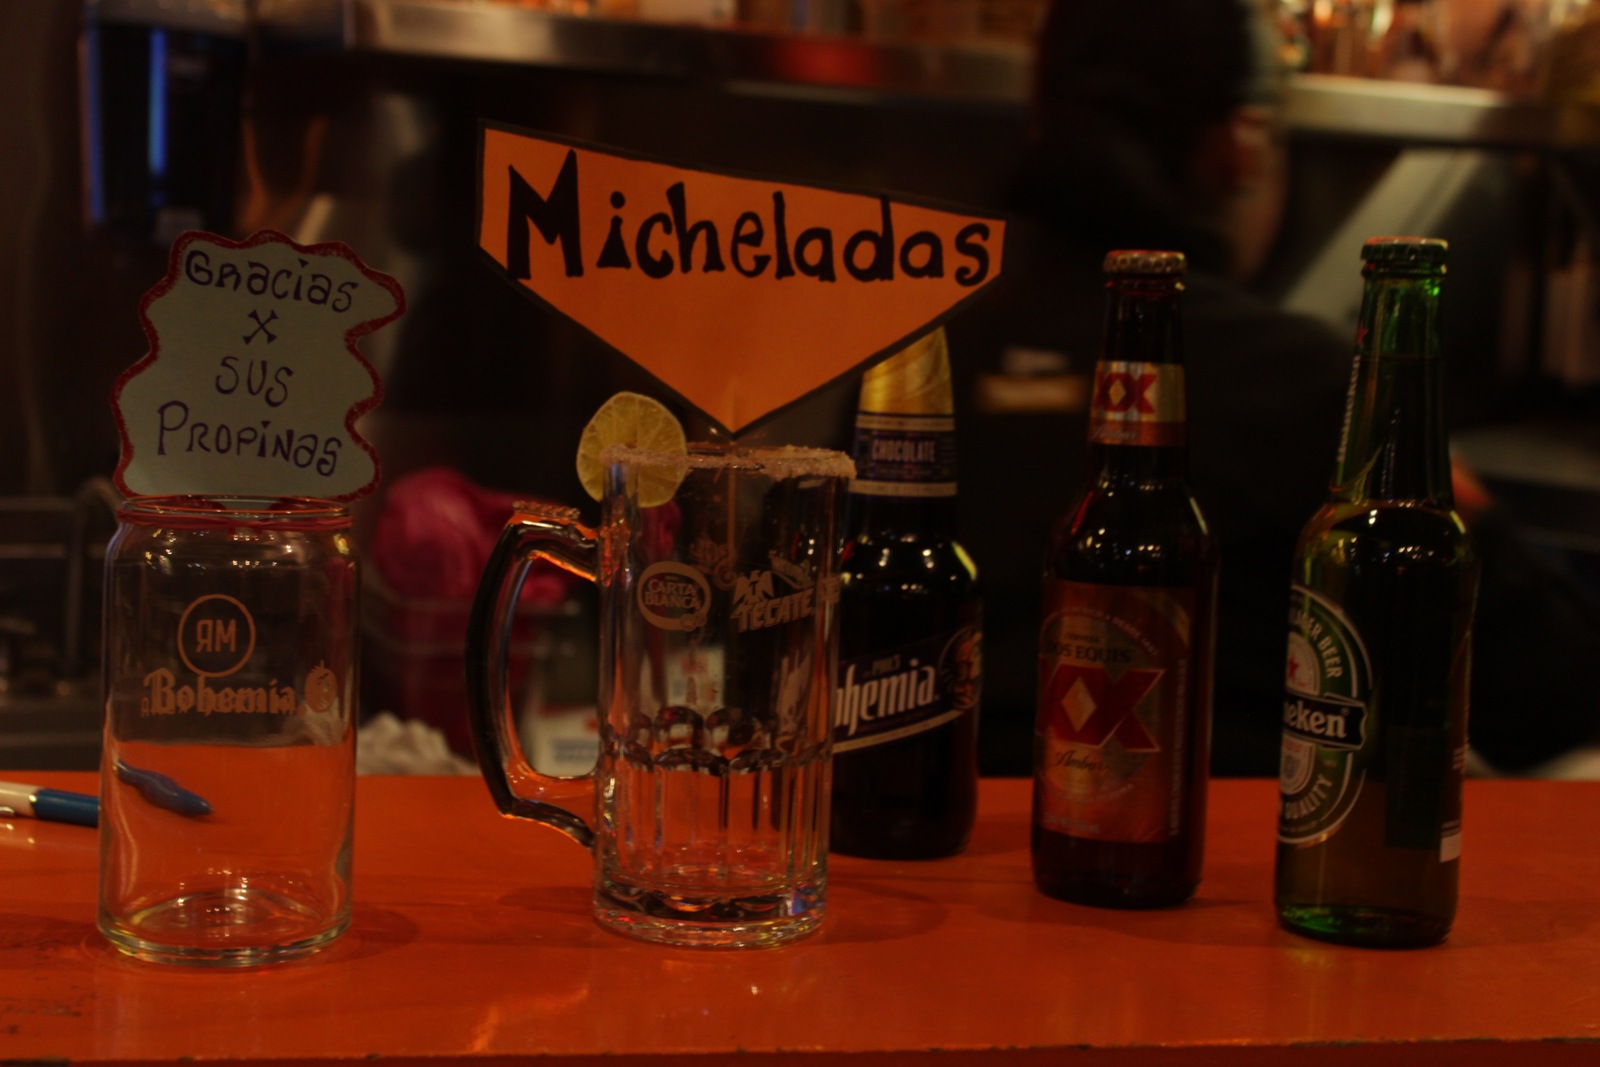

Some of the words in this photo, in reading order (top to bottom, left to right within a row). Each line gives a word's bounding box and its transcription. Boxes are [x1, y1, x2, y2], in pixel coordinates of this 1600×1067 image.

[506, 149, 990, 287] Micheladas
[185, 250, 358, 313] Gracias
[644, 591, 698, 610] BLANCA
[649, 578, 697, 597] CARTA
[730, 588, 817, 634] TECATE
[1075, 644, 1132, 664] EQUIS
[1317, 636, 1344, 680] BEER
[143, 667, 297, 717] Bohemia
